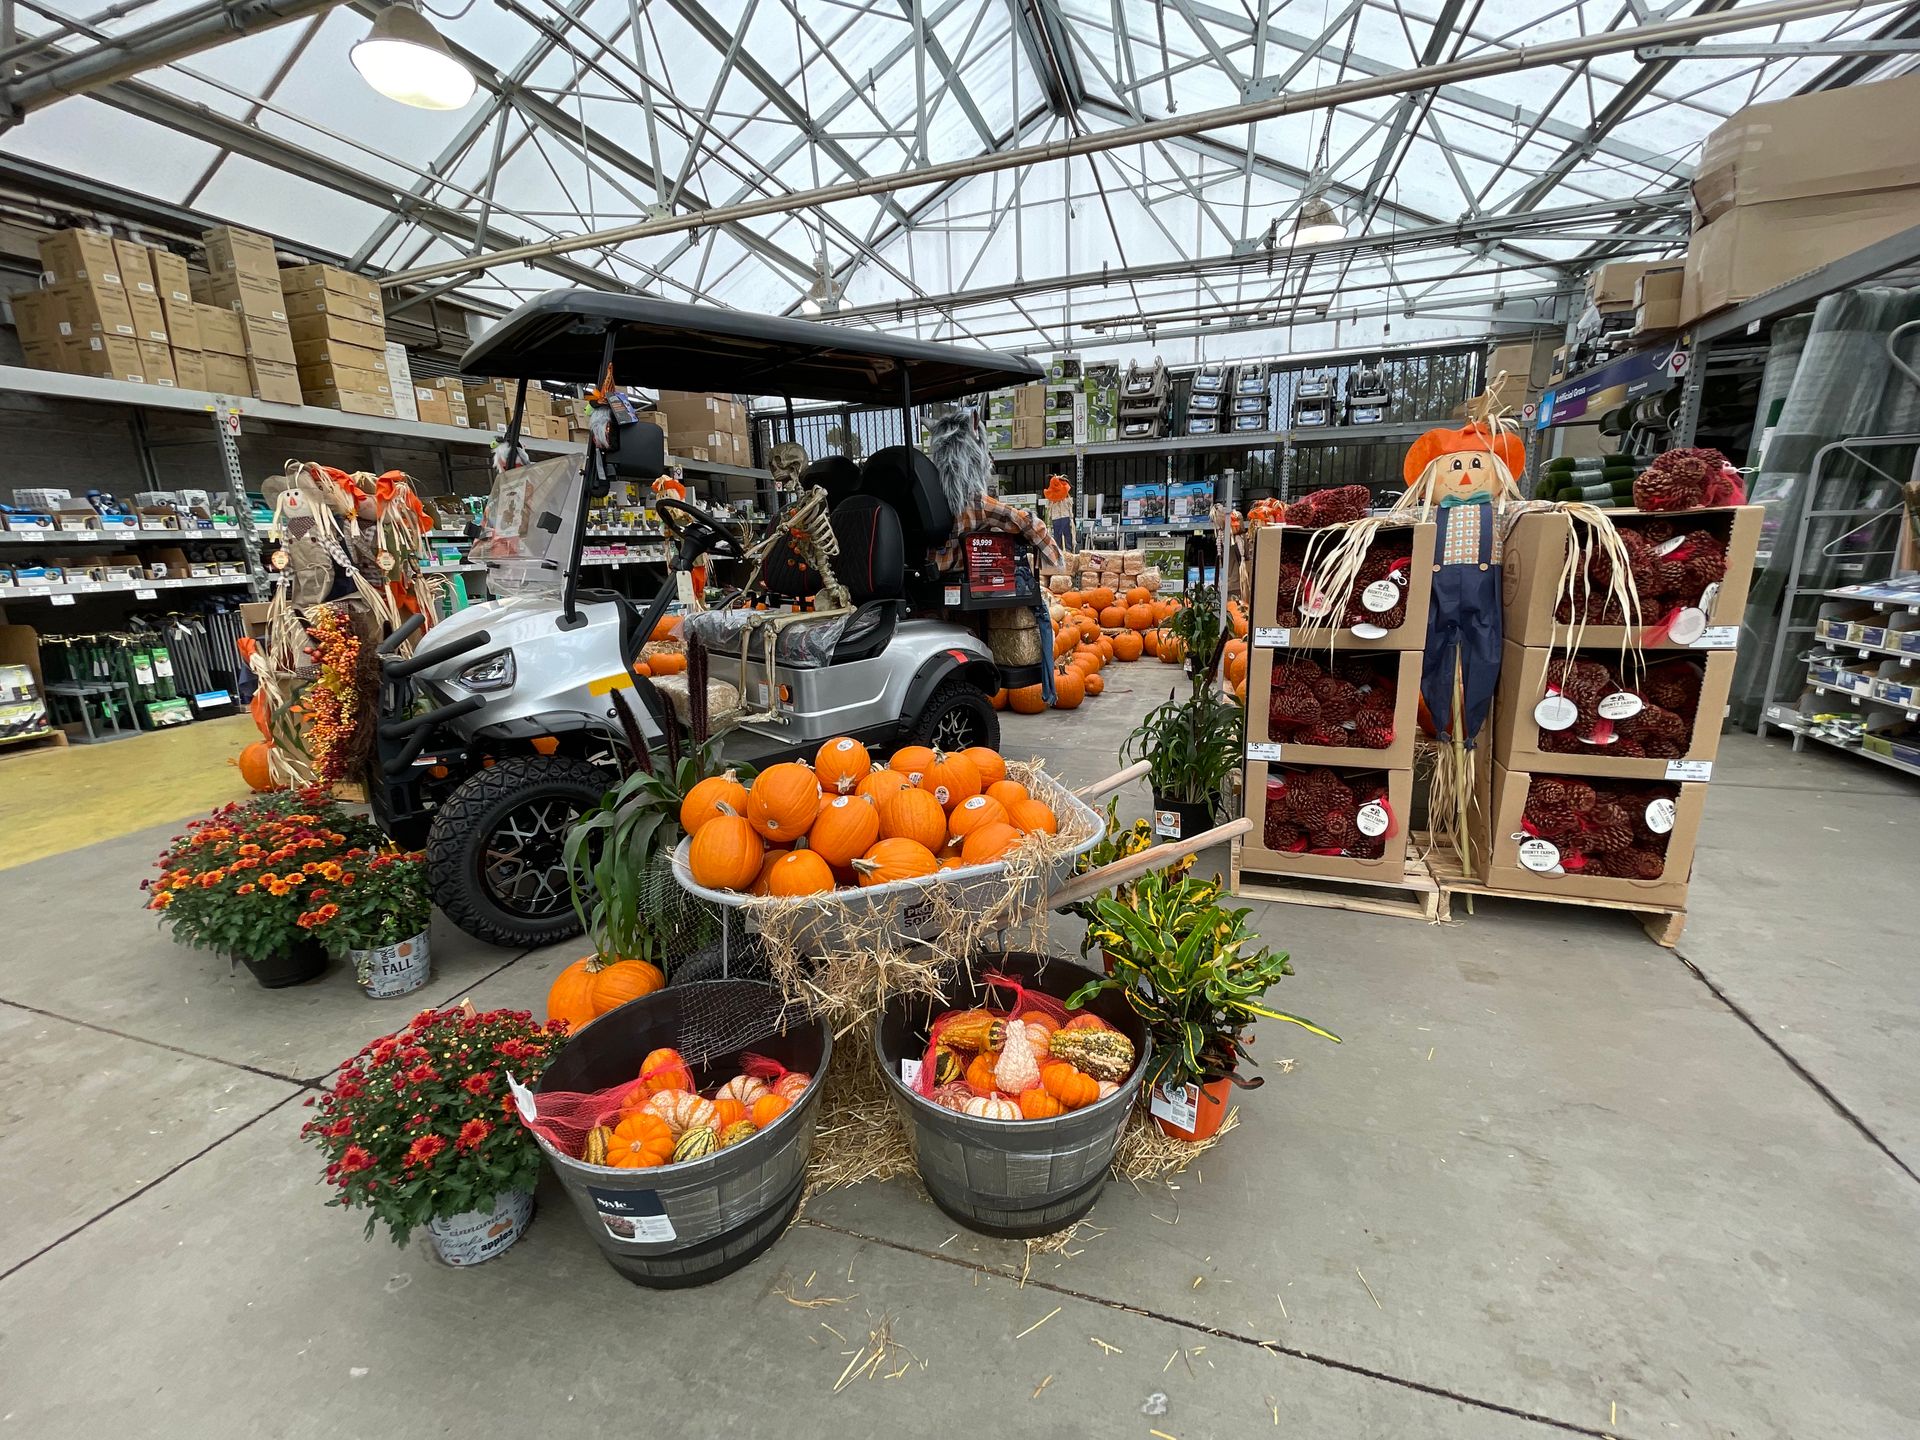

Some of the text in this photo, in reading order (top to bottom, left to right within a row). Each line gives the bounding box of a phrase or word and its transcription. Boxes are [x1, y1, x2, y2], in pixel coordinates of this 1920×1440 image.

[1555, 389, 1574, 404] Artificial
[1573, 386, 1587, 398] Grass
[972, 538, 993, 547] $9,999
[381, 958, 414, 976] FALL
[378, 987, 405, 998] Leaves
[449, 1208, 509, 1237] cinnamon
[480, 1228, 514, 1252] apples
